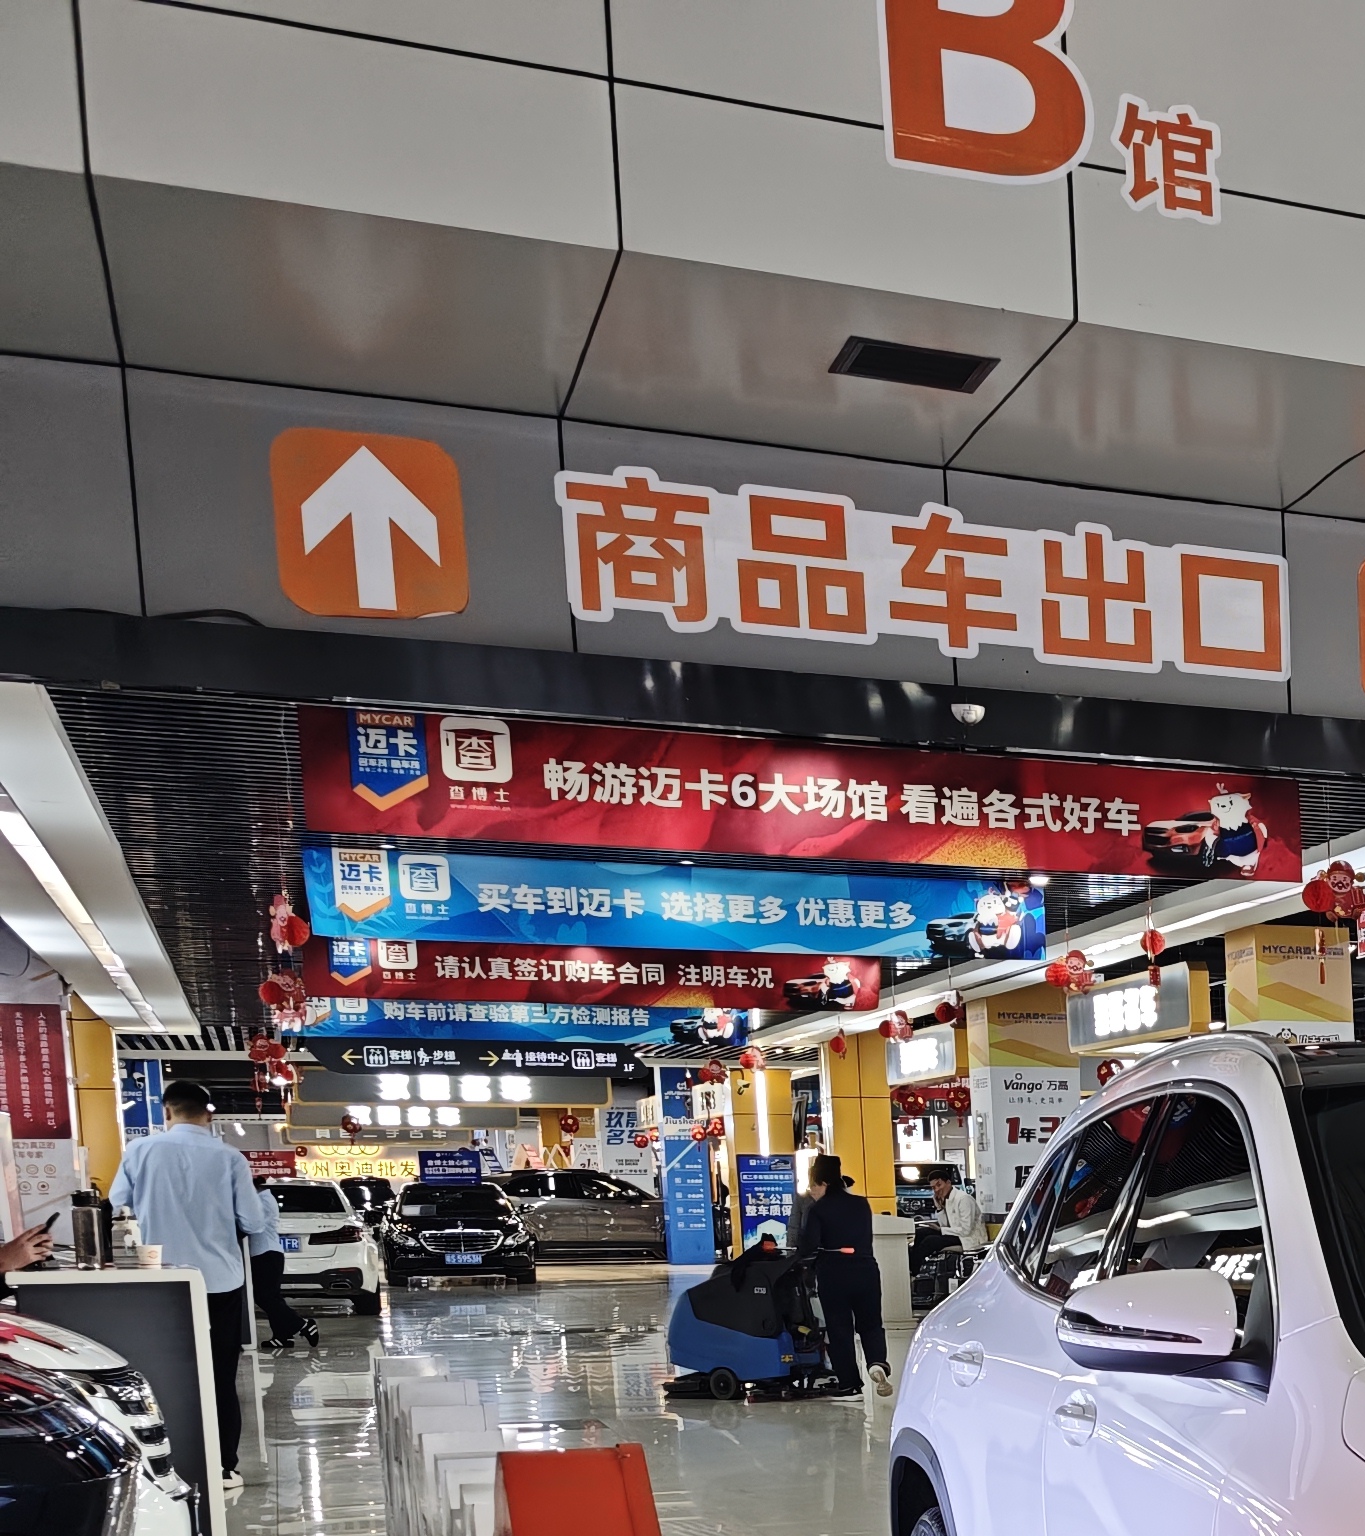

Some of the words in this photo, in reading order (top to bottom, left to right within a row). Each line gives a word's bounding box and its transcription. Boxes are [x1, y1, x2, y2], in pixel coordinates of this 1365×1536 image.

[883, 0, 1093, 184] B
[1117, 102, 1218, 219] 馆
[561, 474, 1286, 680] 商品车出口
[358, 713, 414, 727] MYCAR
[356, 726, 418, 757] 迈卡
[449, 785, 510, 803] 查博士
[543, 756, 889, 822] 畅游迈卡6大场馆
[900, 783, 1142, 838] 看遍各式好车
[340, 853, 381, 863] MYCAR
[339, 862, 382, 883] 迈卡
[476, 881, 645, 920] 买车到迈卡
[661, 890, 785, 926] 选择更多
[795, 895, 917, 930] 优惠更多
[332, 941, 366, 957] 迈卡
[433, 954, 666, 987] 请认真签订购车合同
[677, 962, 775, 990] 注明车况
[383, 1000, 651, 1028] 购车前请查验第三方检测报告
[524, 1050, 570, 1063] 接待中心
[623, 1063, 635, 1072] 1F
[1003, 1078, 1044, 1094] Vango
[744, 1204, 793, 1217] 整车质保
